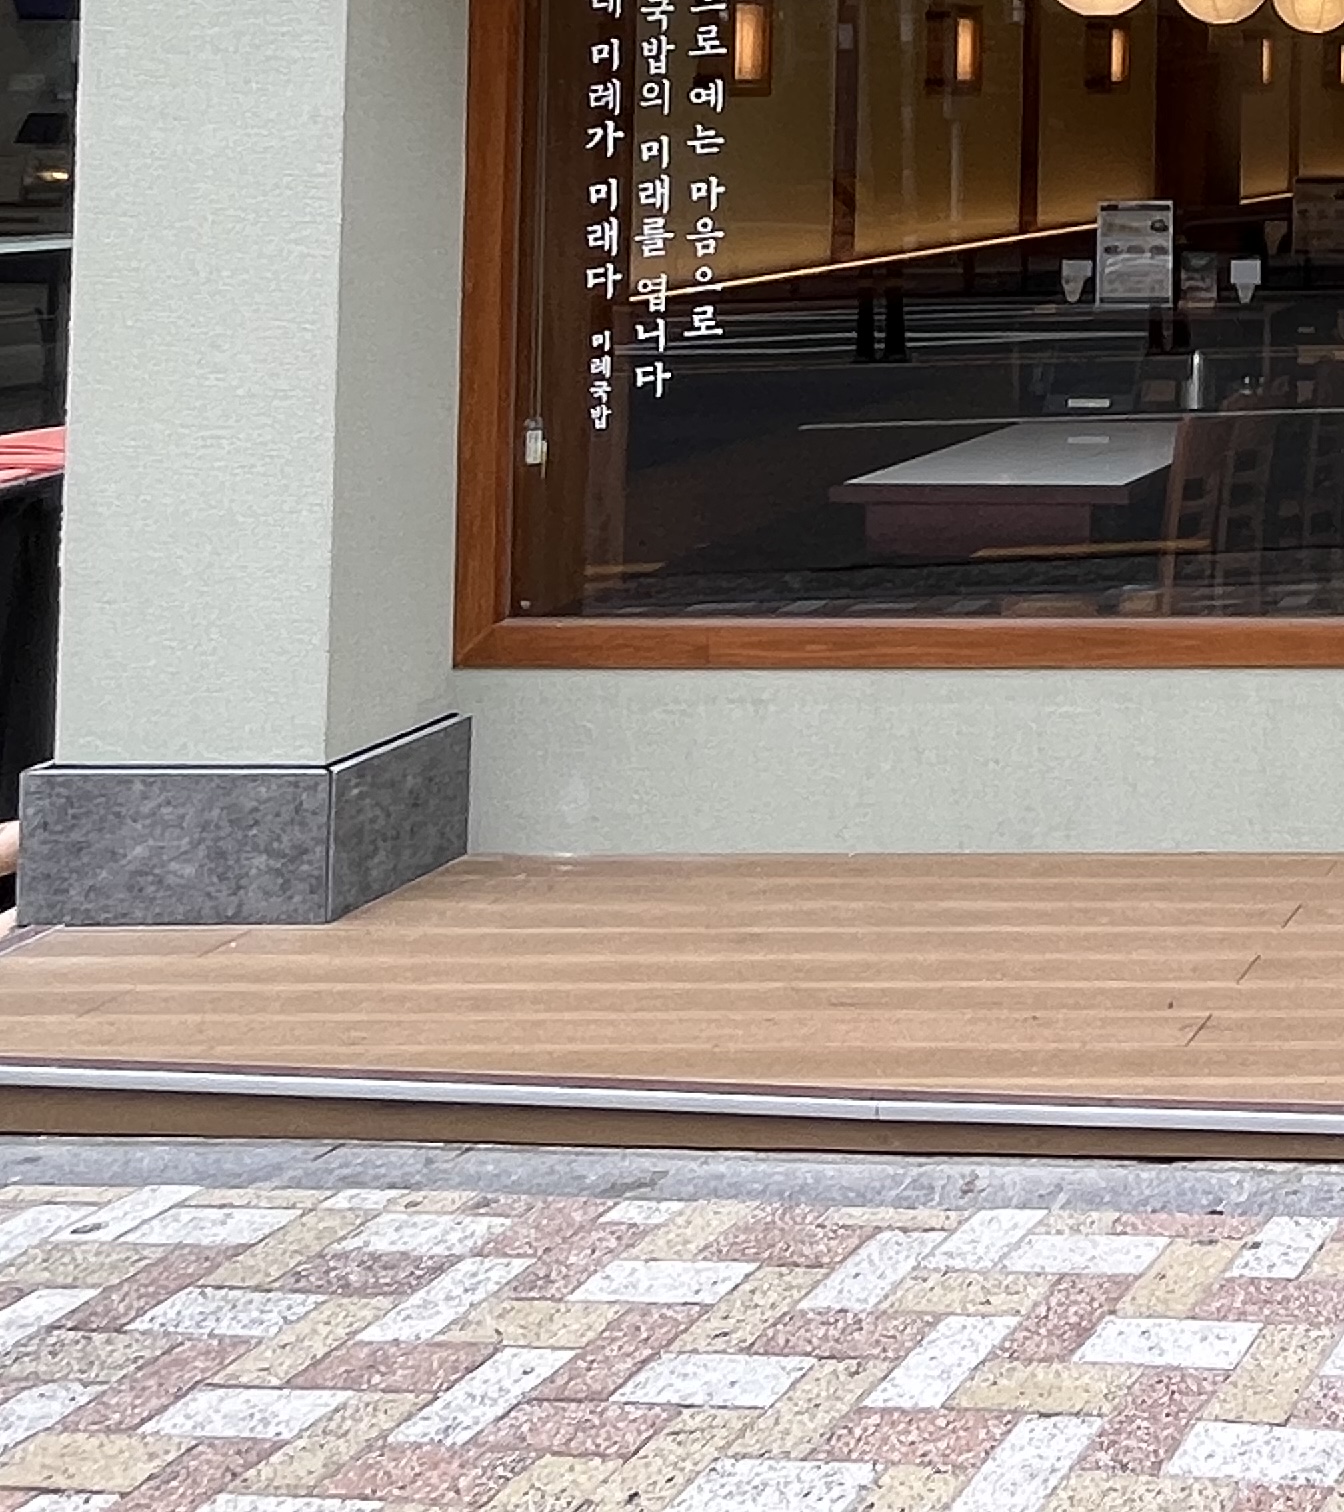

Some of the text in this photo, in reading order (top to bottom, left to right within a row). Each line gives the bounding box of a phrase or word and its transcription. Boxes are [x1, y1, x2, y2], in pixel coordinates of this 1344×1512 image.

[585, 38, 625, 158] 미례가
[687, 79, 725, 154] 예는
[586, 178, 623, 300] 미래다
[634, 135, 674, 258] 미래를
[684, 176, 726, 337] 마음으로
[589, 330, 612, 429] 미례국밥
[634, 274, 672, 398] 엽니다
